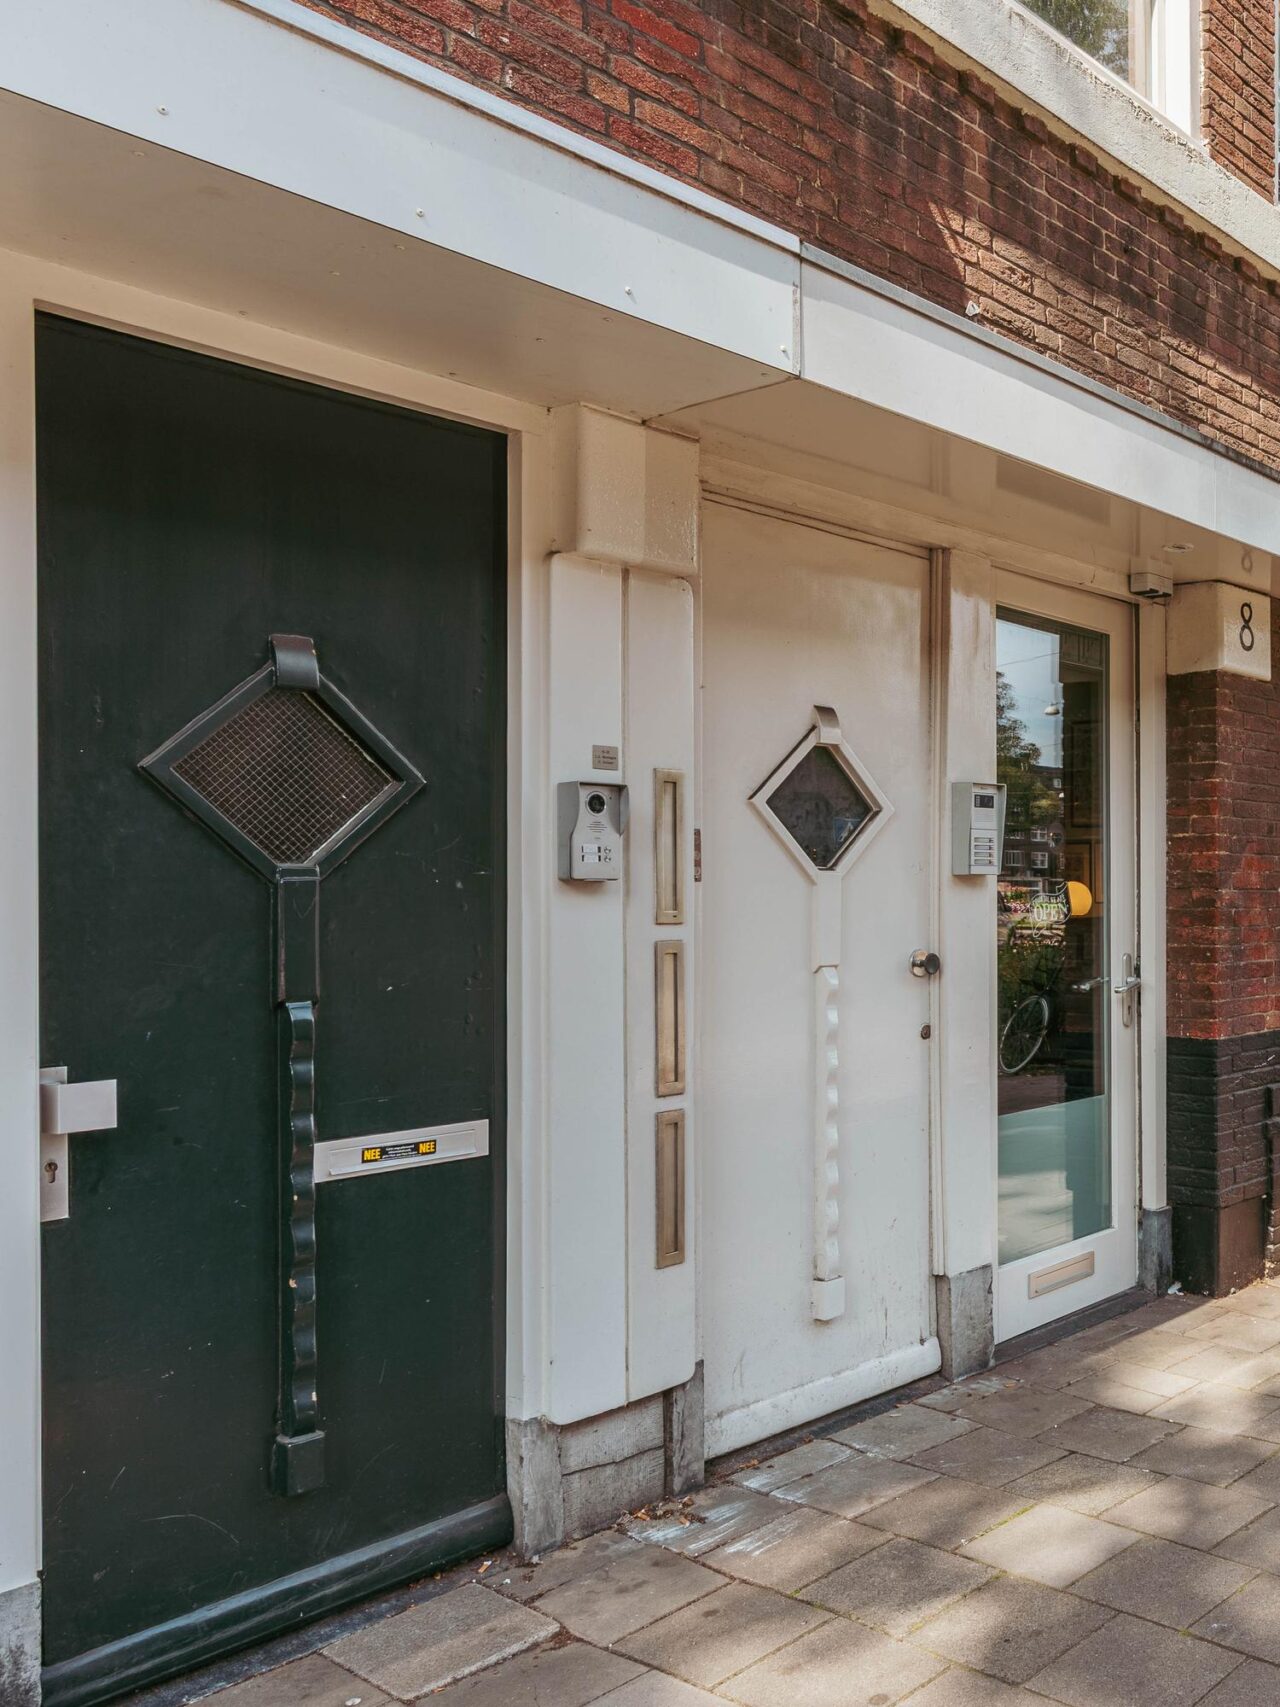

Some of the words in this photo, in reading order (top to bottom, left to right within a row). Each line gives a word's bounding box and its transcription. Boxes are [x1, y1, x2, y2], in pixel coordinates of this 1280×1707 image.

[1240, 602, 1254, 651] 8
[1033, 900, 1068, 921] OPEN
[364, 1149, 381, 1160] NEE
[419, 1141, 435, 1153] NEE
